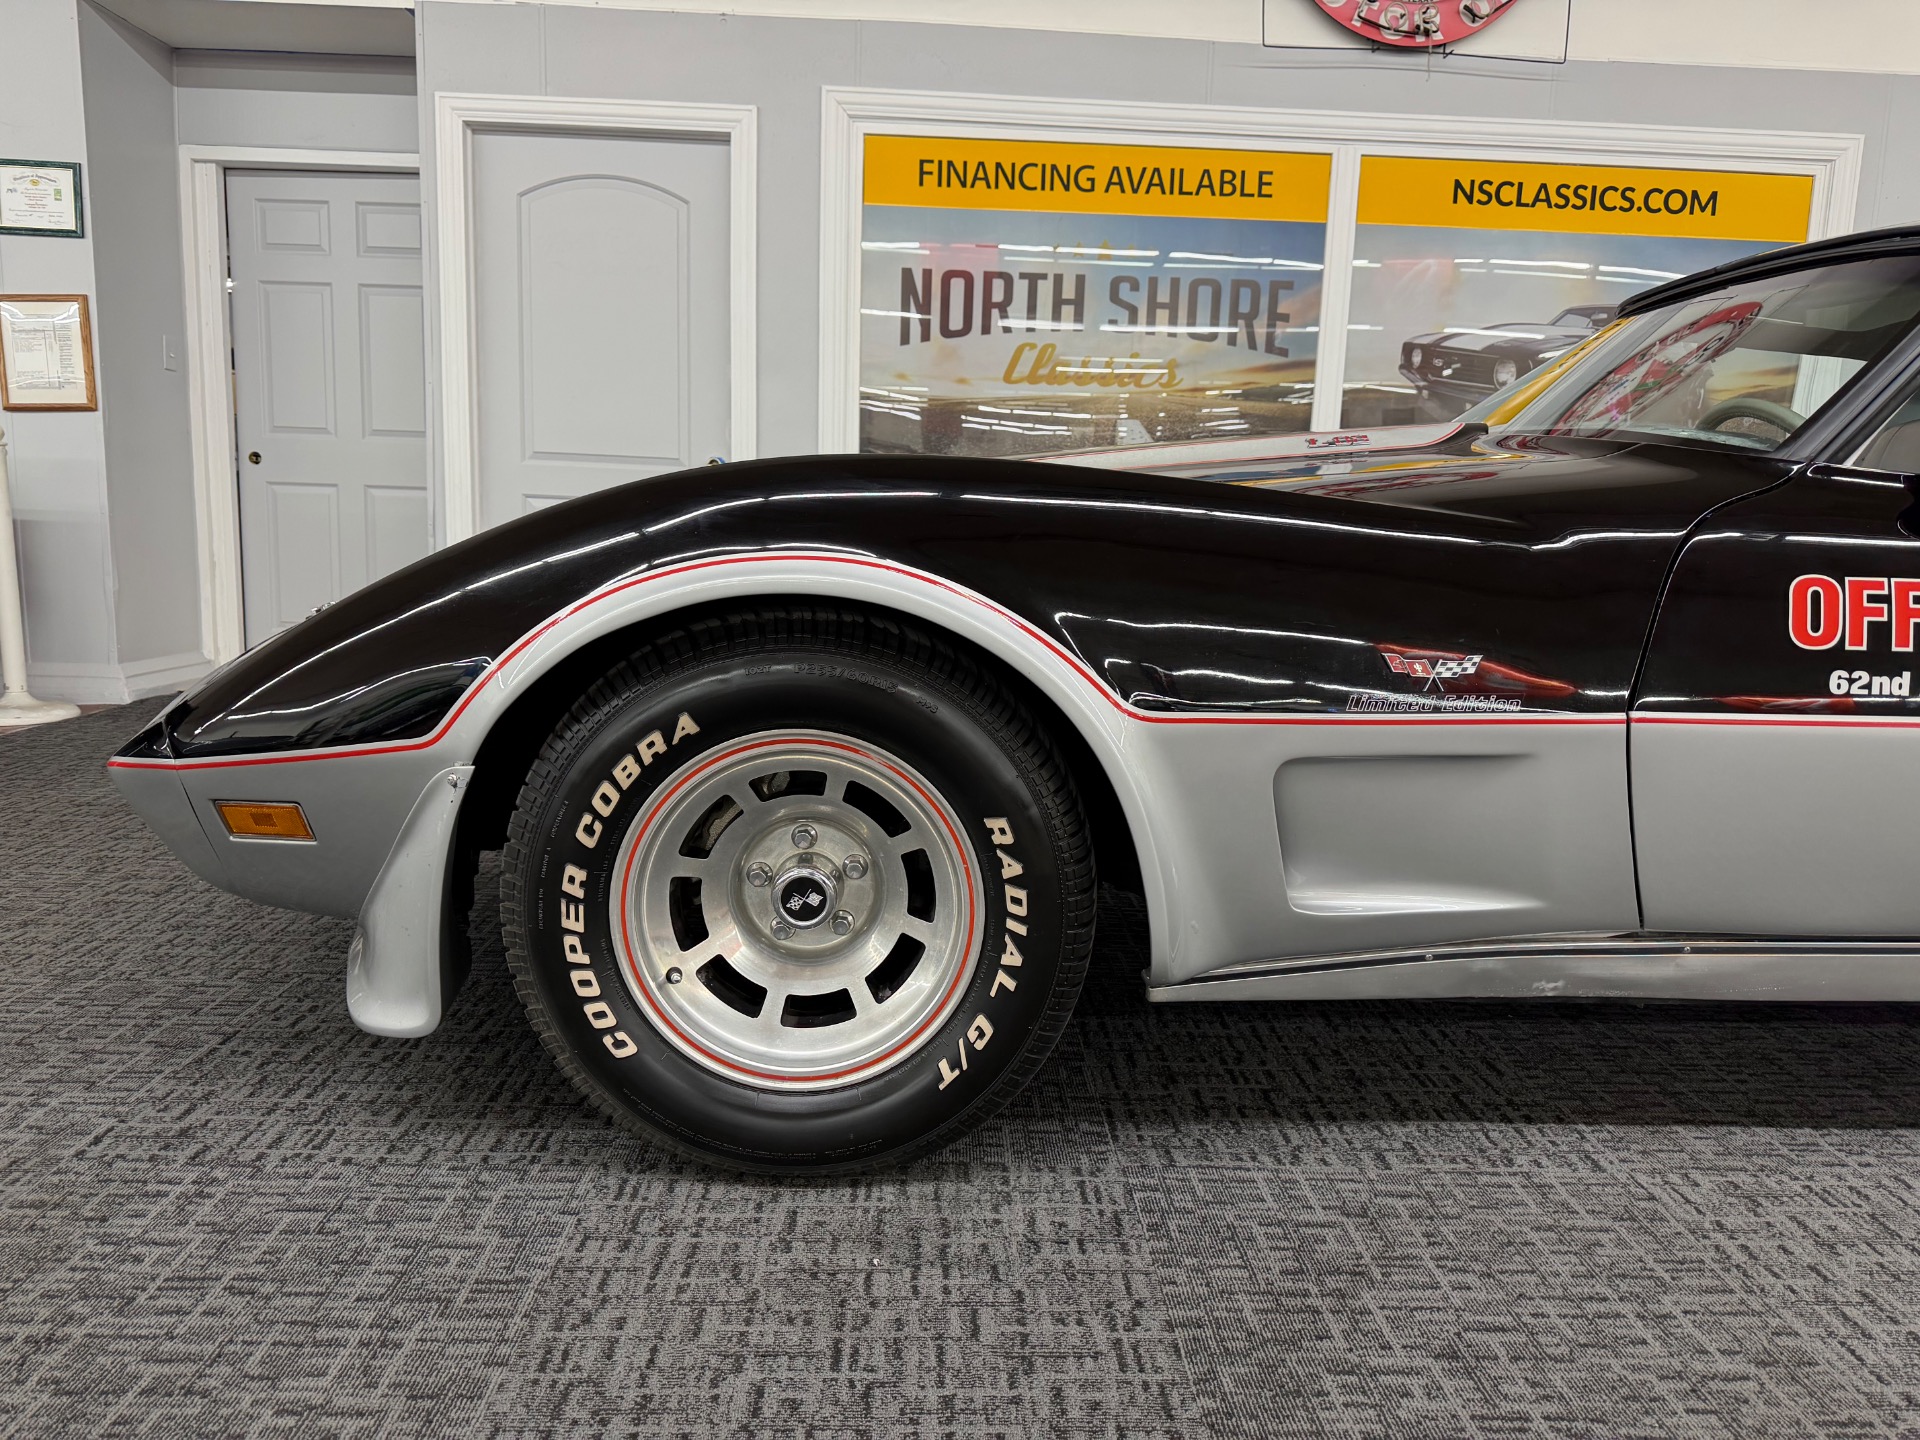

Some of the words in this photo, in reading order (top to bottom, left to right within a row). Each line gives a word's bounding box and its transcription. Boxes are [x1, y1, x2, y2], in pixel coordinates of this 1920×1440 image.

[918, 159, 1098, 195] FINANCING
[1104, 165, 1274, 199] AVAILABLE
[1452, 179, 1719, 217] NSCLASSICS.COM
[899, 266, 1086, 346] NORTH
[1107, 275, 1295, 358] SHORE
[1002, 341, 1184, 389] Classics
[1788, 573, 1920, 652] OFF
[1346, 694, 1437, 712] Limited
[1442, 694, 1522, 713] Edition
[1828, 669, 1911, 697] 62nd
[574, 711, 701, 849] COBRA
[984, 816, 1029, 999] RADIAL
[560, 862, 638, 1060] COOPER
[938, 1012, 995, 1091] G/T
